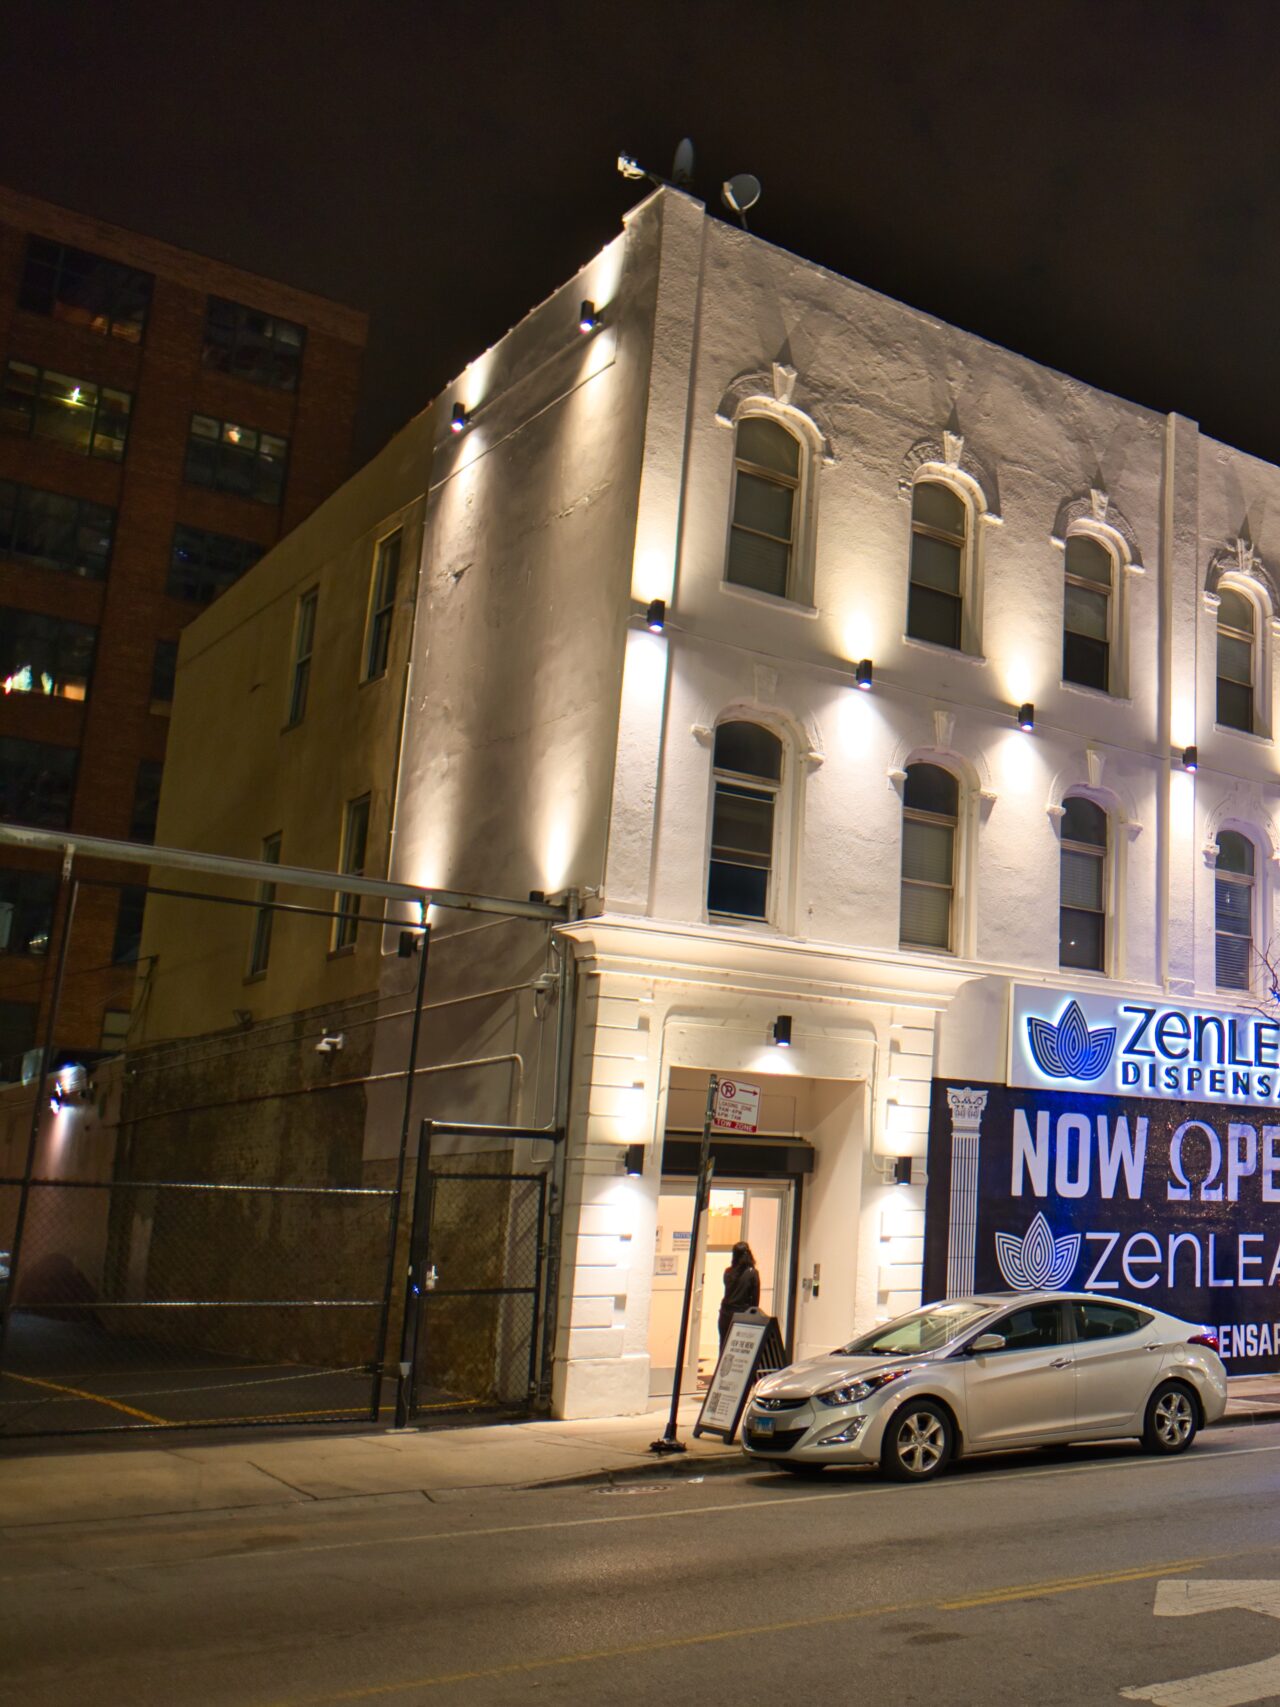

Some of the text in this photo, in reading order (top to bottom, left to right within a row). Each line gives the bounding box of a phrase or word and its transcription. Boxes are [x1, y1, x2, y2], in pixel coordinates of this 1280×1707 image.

[717, 1119, 752, 1132] TOW ZONE
[1011, 1108, 1149, 1199] NOW
